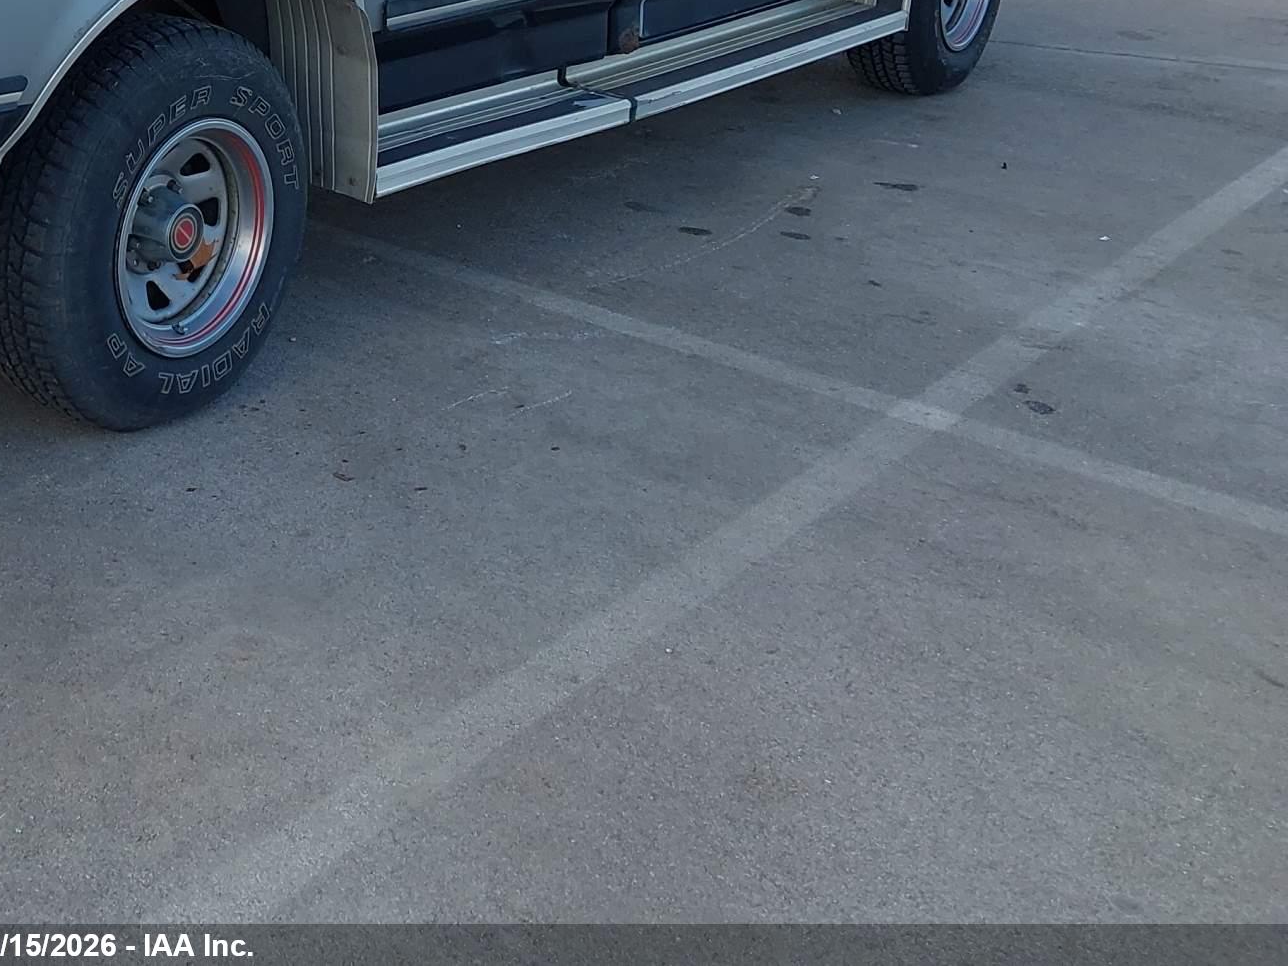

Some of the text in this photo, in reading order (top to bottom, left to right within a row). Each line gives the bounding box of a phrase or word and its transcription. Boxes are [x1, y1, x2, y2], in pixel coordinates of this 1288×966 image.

[112, 85, 299, 211] SUPER SPORT
[159, 302, 271, 394] RADIAL
